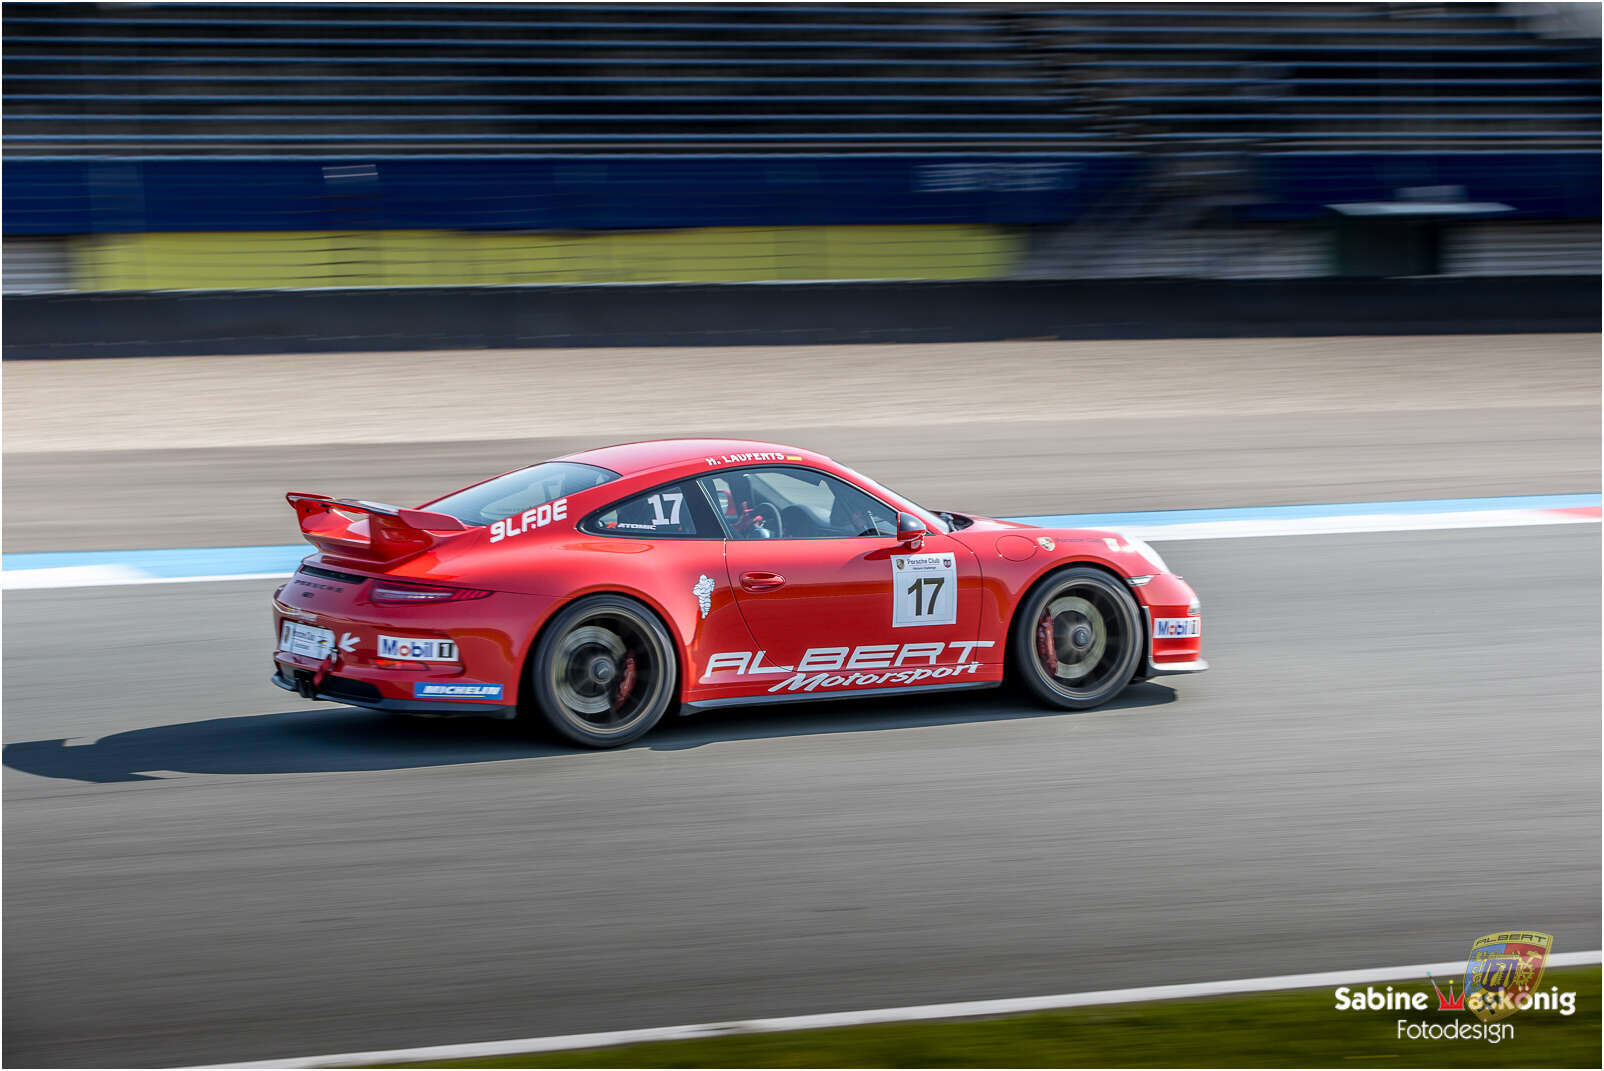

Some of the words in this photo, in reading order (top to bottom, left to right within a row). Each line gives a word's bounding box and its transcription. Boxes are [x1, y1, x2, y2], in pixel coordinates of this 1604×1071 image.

[648, 493, 684, 526] 17
[907, 577, 945, 616] 17
[381, 638, 433, 657] Mobil
[705, 641, 995, 678] ALBERT
[422, 685, 501, 695] MICHELIN
[767, 662, 984, 692] Motorsport
